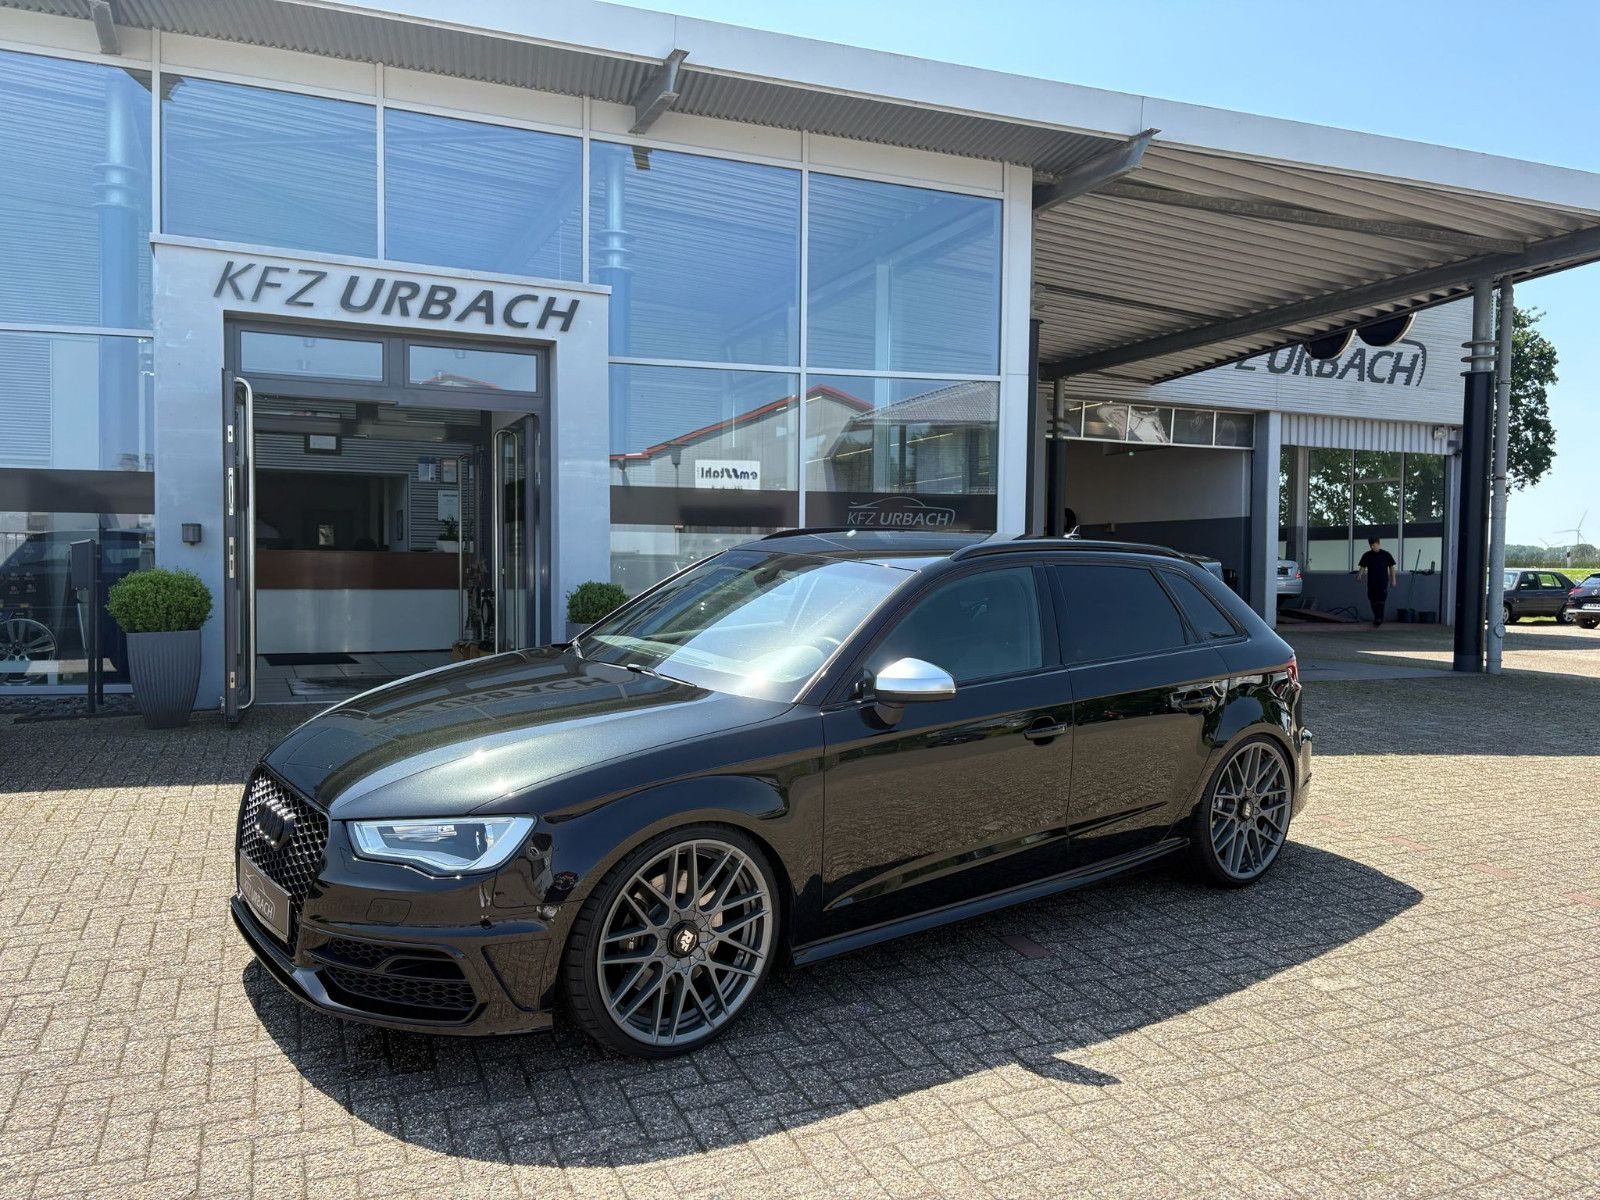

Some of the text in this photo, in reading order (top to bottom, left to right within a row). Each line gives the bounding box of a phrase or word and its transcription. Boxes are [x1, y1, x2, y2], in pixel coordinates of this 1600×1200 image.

[213, 260, 580, 332] KFZ URBACH
[846, 511, 951, 526] KFZ URBACH
